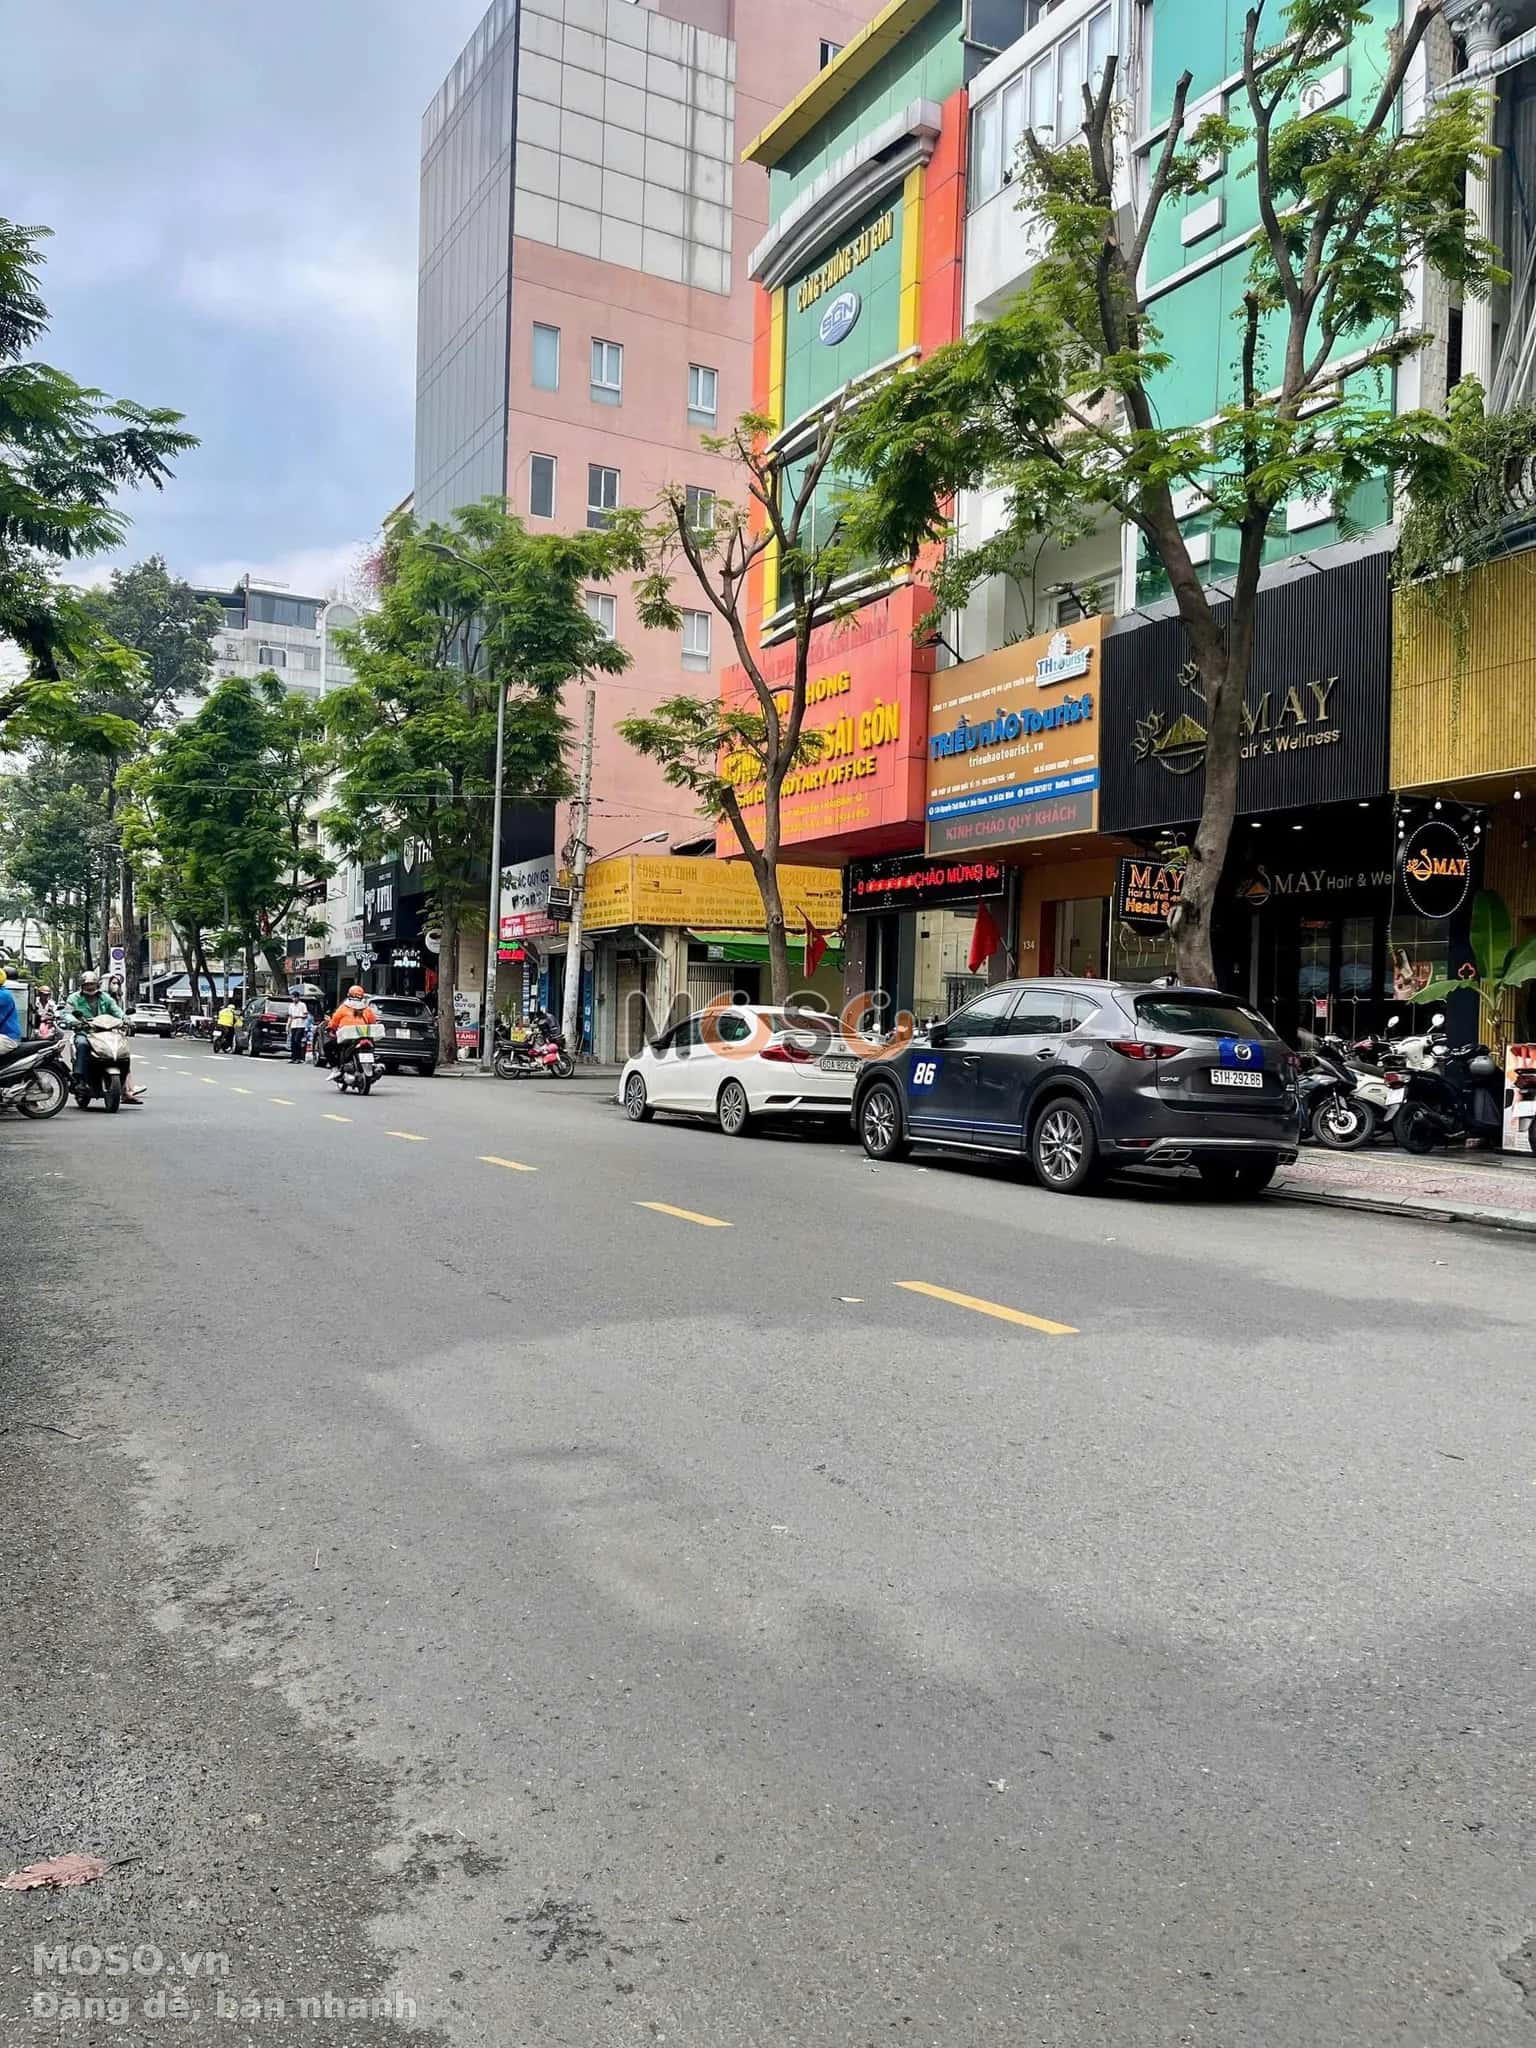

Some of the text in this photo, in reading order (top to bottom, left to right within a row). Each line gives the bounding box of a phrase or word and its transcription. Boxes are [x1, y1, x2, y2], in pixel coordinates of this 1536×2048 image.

[853, 226, 871, 266] SÀI
[870, 210, 894, 252] GÒN
[805, 671, 851, 705] HÒNG
[859, 698, 900, 750] GÒN
[1021, 692, 1094, 734] Tourist
[1240, 729, 1341, 759] air & Wellness
[829, 757, 877, 784] OFFICE
[975, 815, 1005, 835] CHÀO
[1034, 801, 1078, 826] KHÁCH
[914, 867, 945, 888] CHÀO
[947, 863, 983, 884] MỪNG
[1129, 864, 1186, 892] MAY
[1433, 857, 1468, 876] MAY
[1127, 887, 1144, 898] Hair
[1275, 869, 1326, 895] MAY
[1327, 877, 1352, 890] Hair
[1357, 873, 1368, 887] &
[1125, 897, 1159, 915] Head
[913, 1062, 937, 1085] 86
